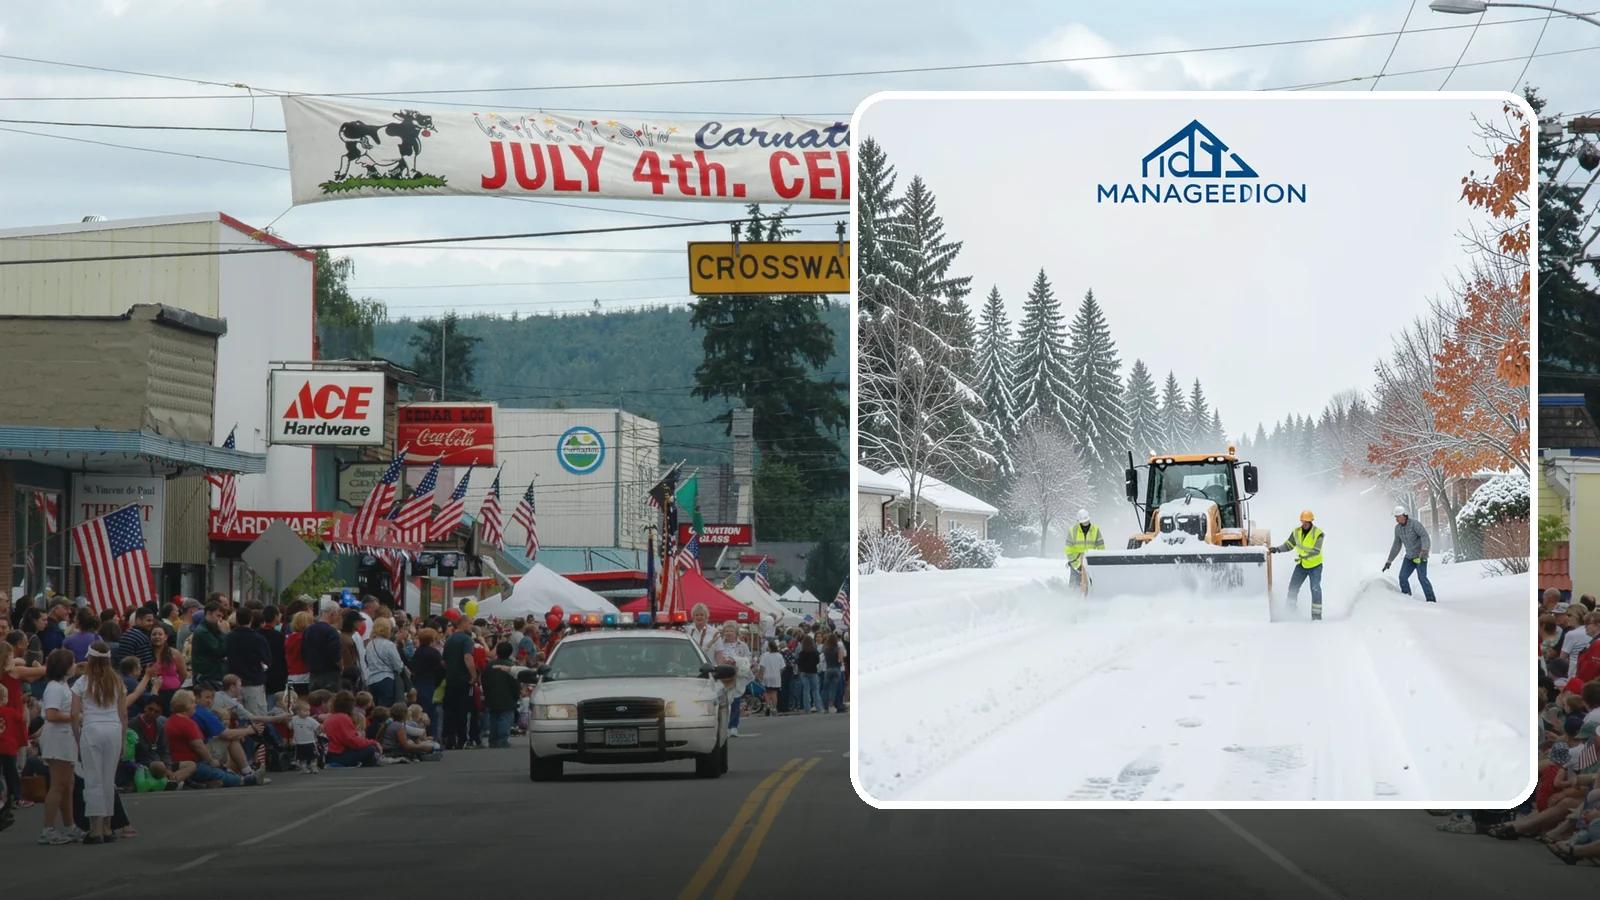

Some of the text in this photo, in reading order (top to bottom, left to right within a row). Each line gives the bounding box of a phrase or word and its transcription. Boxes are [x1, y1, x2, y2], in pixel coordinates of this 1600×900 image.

[481, 141, 605, 192] JULY
[632, 150, 746, 198] 4th.
[697, 254, 850, 280] CROSSWA
[283, 380, 373, 420] ACE
[406, 408, 452, 421] CEDAR
[283, 421, 371, 437] Hardware
[416, 428, 477, 447] Coca-Cola
[353, 467, 385, 480] Simpl
[96, 485, 124, 495] Vincent
[126, 485, 135, 495] de
[137, 486, 155, 496] Paul
[688, 526, 742, 535] CRNATION
